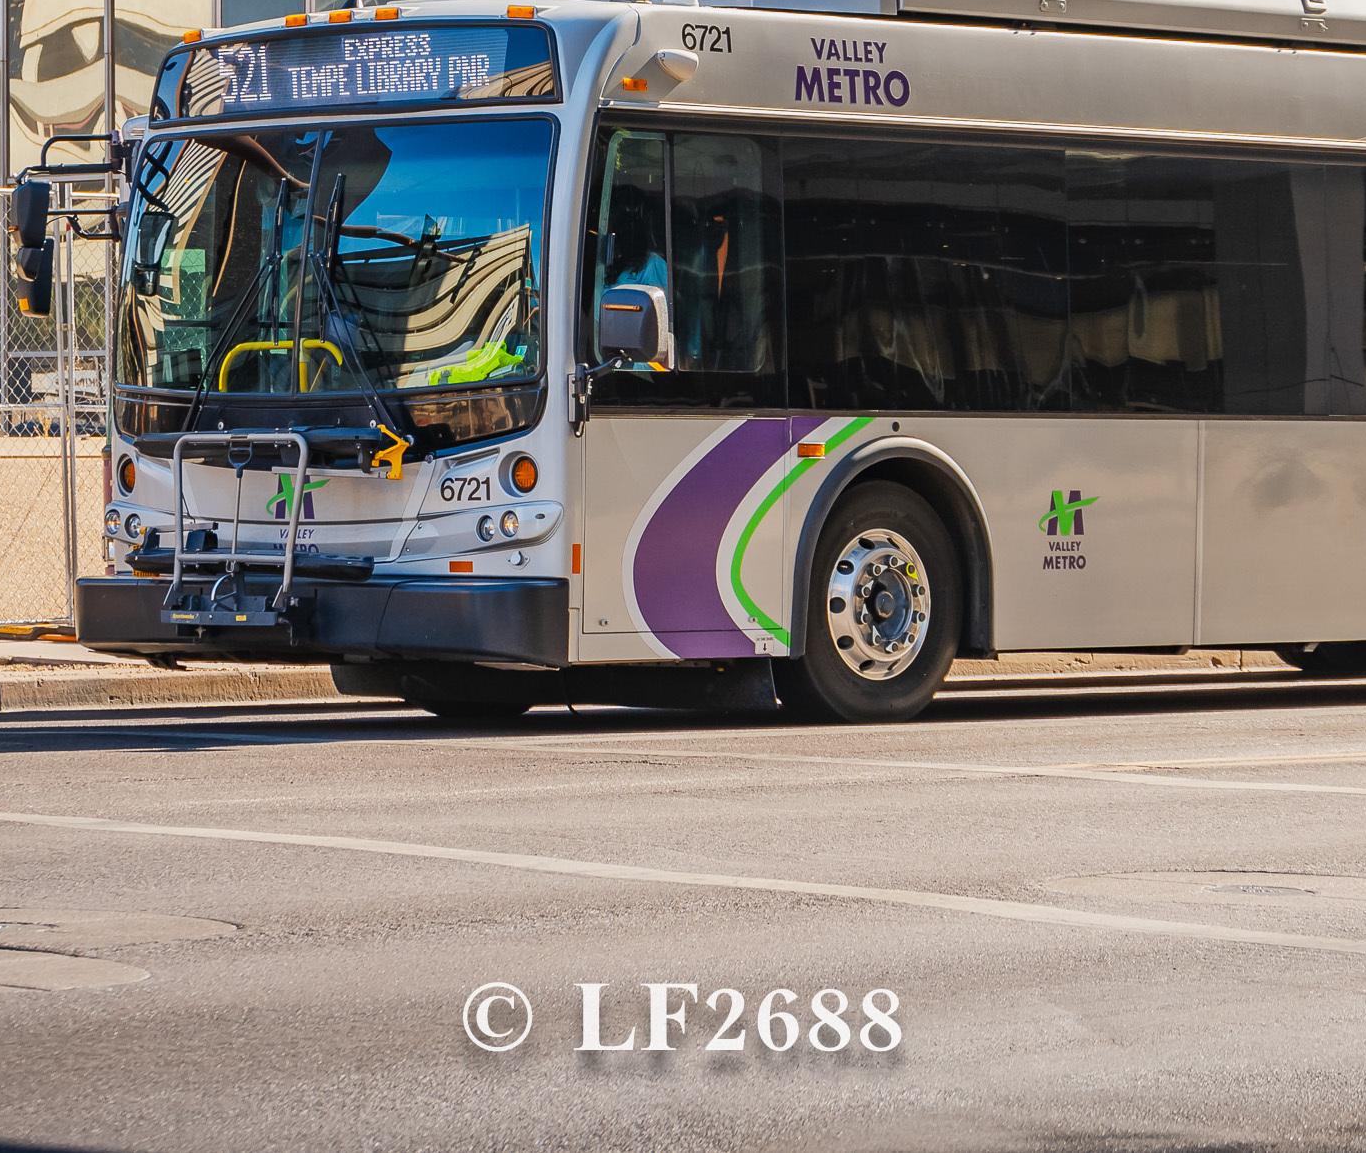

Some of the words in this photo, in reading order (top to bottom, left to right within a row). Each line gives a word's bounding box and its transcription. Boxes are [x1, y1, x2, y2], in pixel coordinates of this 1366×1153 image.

[344, 34, 432, 61] EXPRESS
[681, 23, 732, 53] 6721
[810, 37, 887, 64] VALLEY
[217, 45, 272, 103] 521
[288, 63, 351, 99] TEMPE
[356, 57, 442, 95] LIBRARY
[448, 54, 490, 89] PNR
[795, 65, 911, 107] METRO
[440, 476, 491, 502] 6721
[1048, 541, 1081, 551] VALLEY
[1042, 554, 1087, 570] METRO
